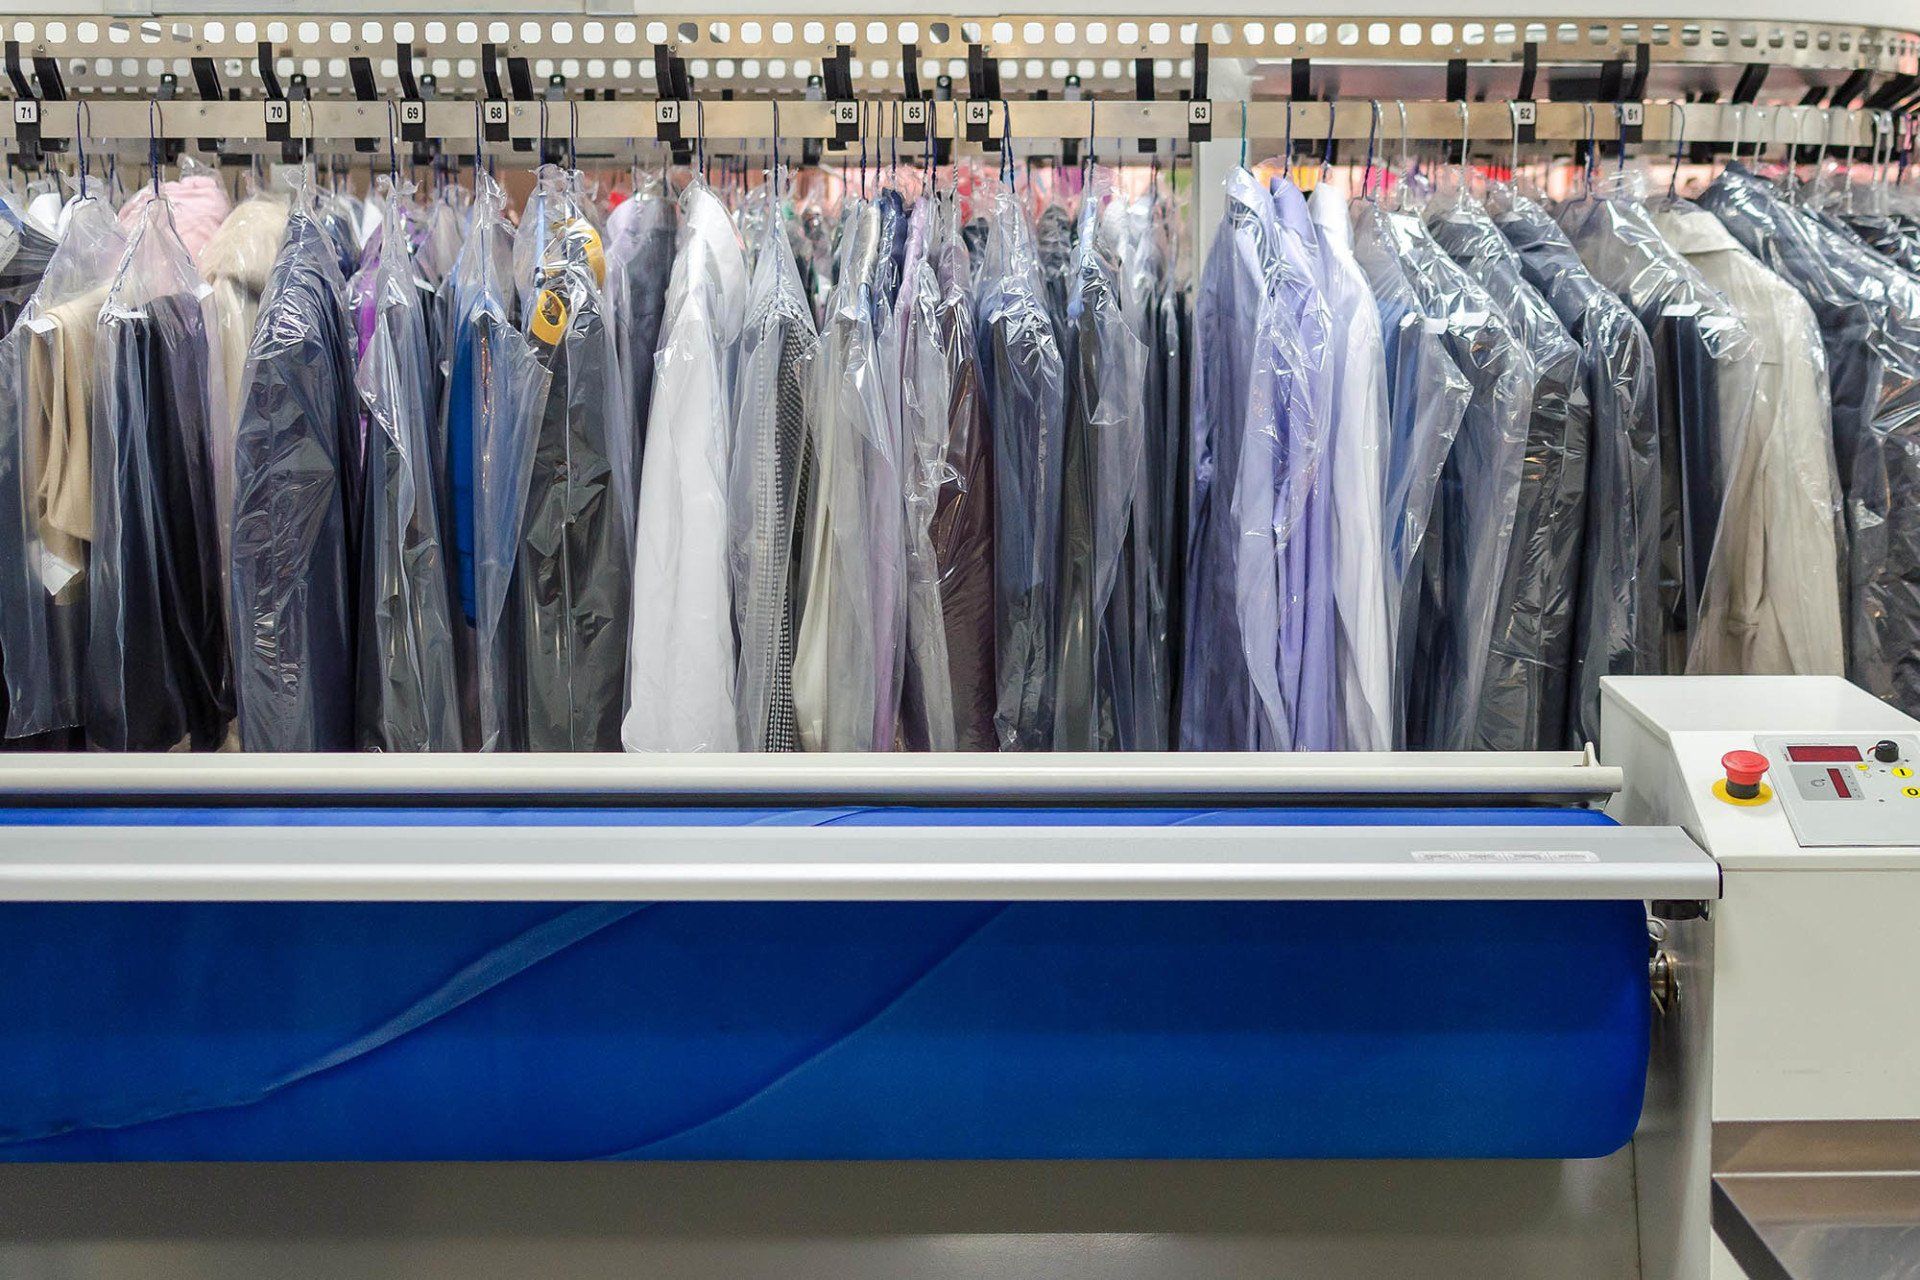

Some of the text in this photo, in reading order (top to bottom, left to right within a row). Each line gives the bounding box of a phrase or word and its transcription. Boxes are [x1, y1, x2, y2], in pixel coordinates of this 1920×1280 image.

[20, 106, 32, 119] 71
[270, 106, 283, 119] 70
[406, 106, 419, 120] 69
[490, 106, 503, 120] 68
[661, 106, 674, 119] 67
[841, 107, 854, 120] 66
[908, 106, 921, 119] 65
[972, 106, 985, 119] 64
[1194, 106, 1207, 120] 63
[1518, 106, 1532, 120] 62
[1626, 107, 1638, 121] 61
